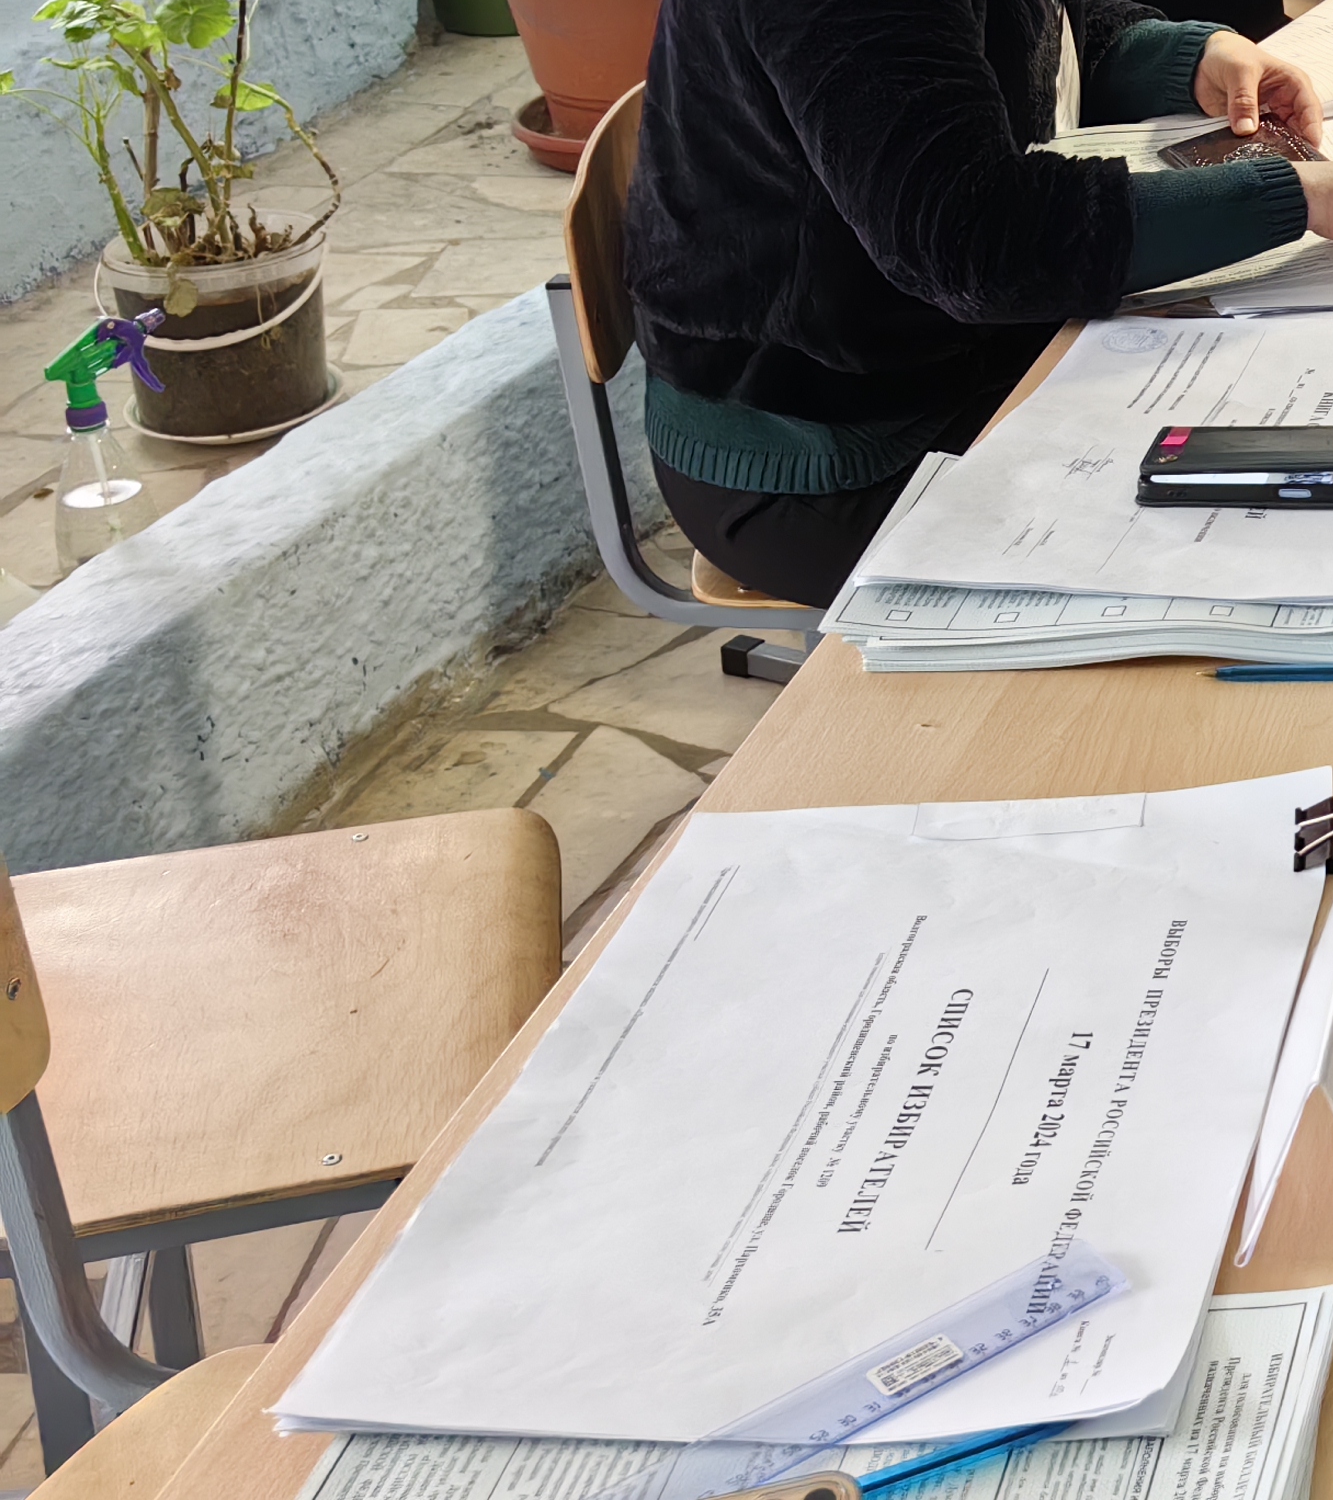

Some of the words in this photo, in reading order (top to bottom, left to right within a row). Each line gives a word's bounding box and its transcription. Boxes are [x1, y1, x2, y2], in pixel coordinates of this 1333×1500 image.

[886, 914, 929, 974] Волгоградская
[1150, 919, 1188, 979] ВЫБОРЫ
[884, 1033, 899, 1044] по
[913, 987, 977, 1077] СПИСОК
[1065, 1030, 1095, 1050] 17
[1110, 988, 1164, 1093] ПРЕЗИДЕНТА
[846, 1045, 896, 1119] избирательному
[1038, 1053, 1082, 1107] марта
[828, 1120, 858, 1153] участку
[834, 1084, 935, 1234] ИЗБИРАТЕЛЕЙ
[1027, 1112, 1066, 1148] 2024
[1067, 1098, 1128, 1202] РОССИЙСКОЙ
[1008, 1150, 1044, 1186] года
[1193, 1360, 1219, 1428] назначенных
[1215, 1356, 1242, 1415] Президента
[1248, 1353, 1283, 1448] ИЗБИРАТЕЛЬНЫЙ
[1186, 1443, 1200, 1455] 17
[1199, 1416, 1226, 1475] Российской
[1223, 1392, 1246, 1454] голосования
[1176, 1457, 1194, 1489] марта
